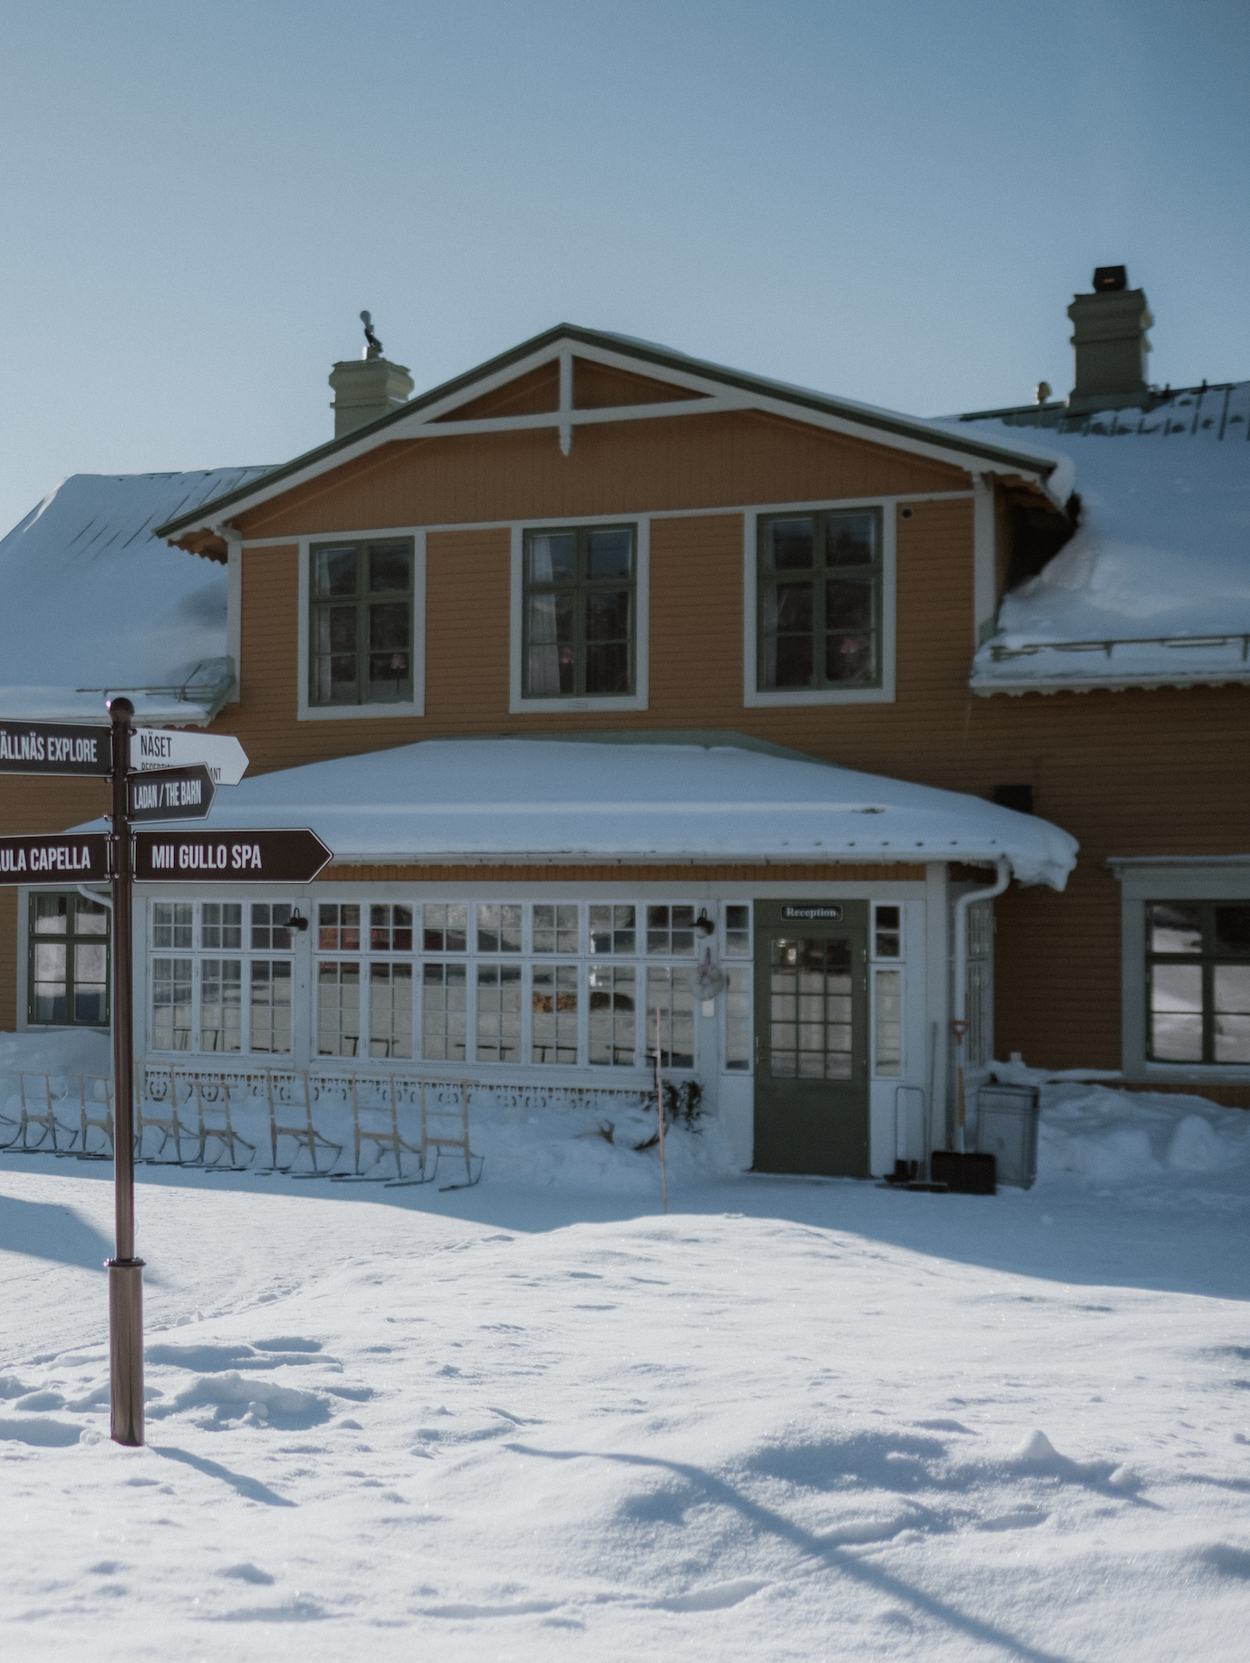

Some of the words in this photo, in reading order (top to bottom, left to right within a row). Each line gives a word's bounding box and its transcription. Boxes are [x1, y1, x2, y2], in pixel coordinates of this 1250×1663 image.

[47, 737, 98, 763] EXPLORE
[140, 731, 172, 758] NÄSET
[134, 784, 158, 810] LADAN
[158, 784, 164, 808] /
[165, 781, 179, 807] THE
[180, 780, 202, 806] BARN
[30, 846, 91, 871] CAPELLA
[152, 845, 175, 869] MII
[179, 845, 227, 869] GULLO
[232, 845, 262, 869] SPA
[786, 907, 837, 919] Reception
